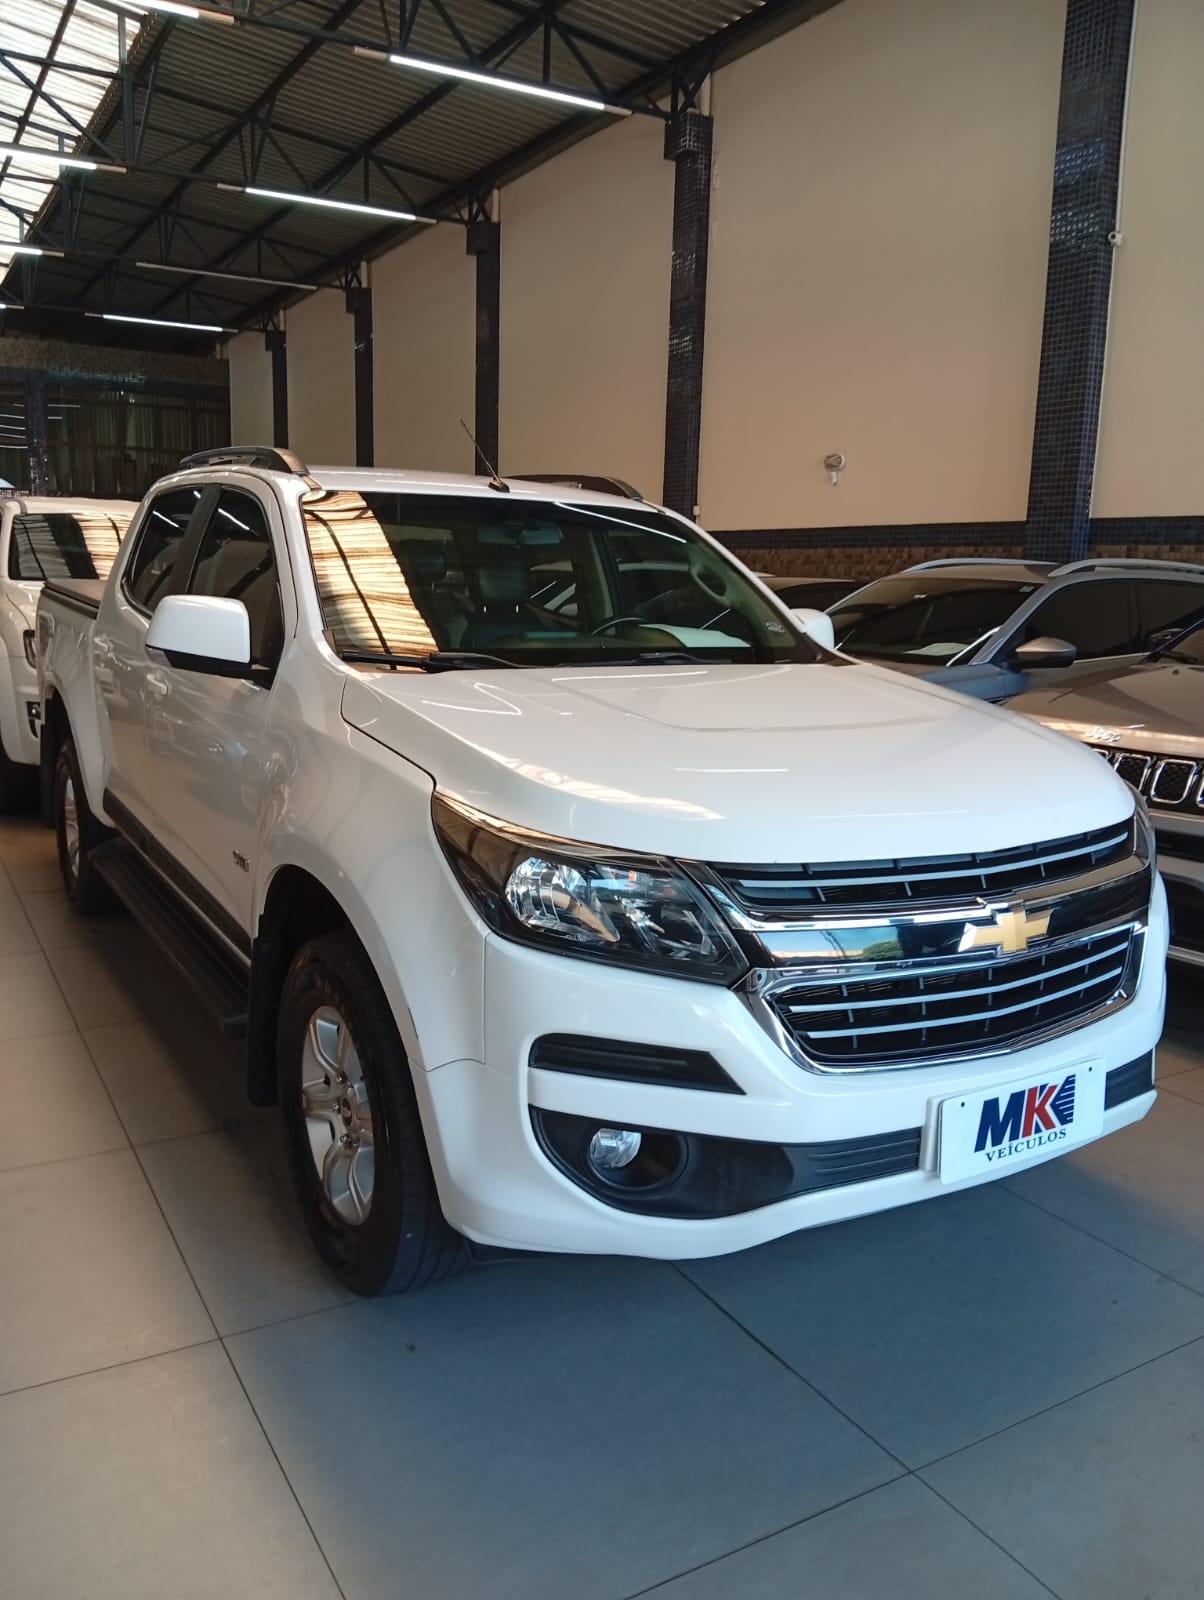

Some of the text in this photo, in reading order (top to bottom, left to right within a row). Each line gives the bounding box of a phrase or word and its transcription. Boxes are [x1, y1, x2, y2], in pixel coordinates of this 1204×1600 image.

[1084, 727, 1121, 745] Jeep
[973, 1083, 1060, 1153] MK
[985, 1128, 1067, 1162] VEÍCULOS
